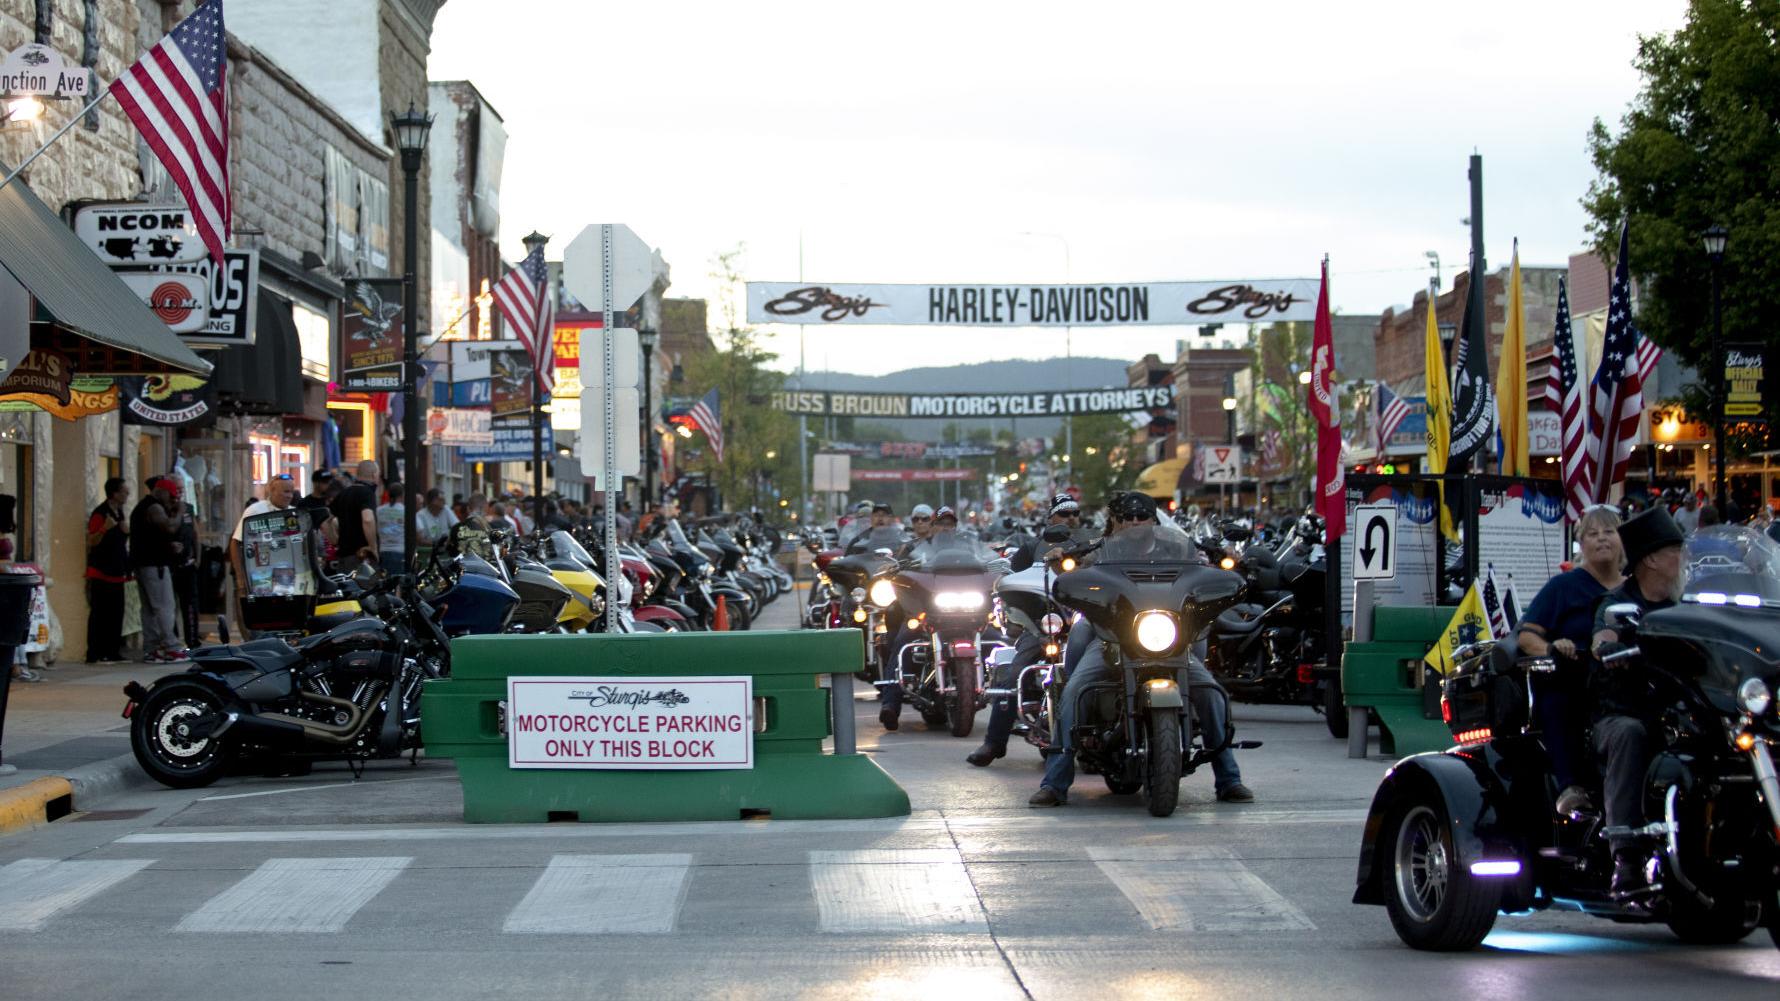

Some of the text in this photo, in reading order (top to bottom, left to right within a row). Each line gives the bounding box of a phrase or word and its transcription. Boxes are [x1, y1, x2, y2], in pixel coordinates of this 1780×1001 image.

[2, 70, 84, 92] nction Ave
[98, 213, 185, 231] NCOM
[928, 286, 1149, 323] HARLEY-DAVIDSON
[2, 375, 62, 391] MPORIUM
[132, 401, 206, 422] UNITED STATES
[771, 387, 1170, 416] RUSS BROWN MOTORCYCLE ATTORNEYS
[590, 686, 652, 710] Sturgis
[518, 714, 742, 733] MOTORCYCLE PARKING
[545, 740, 715, 757] ONLY THIS BLOCK
